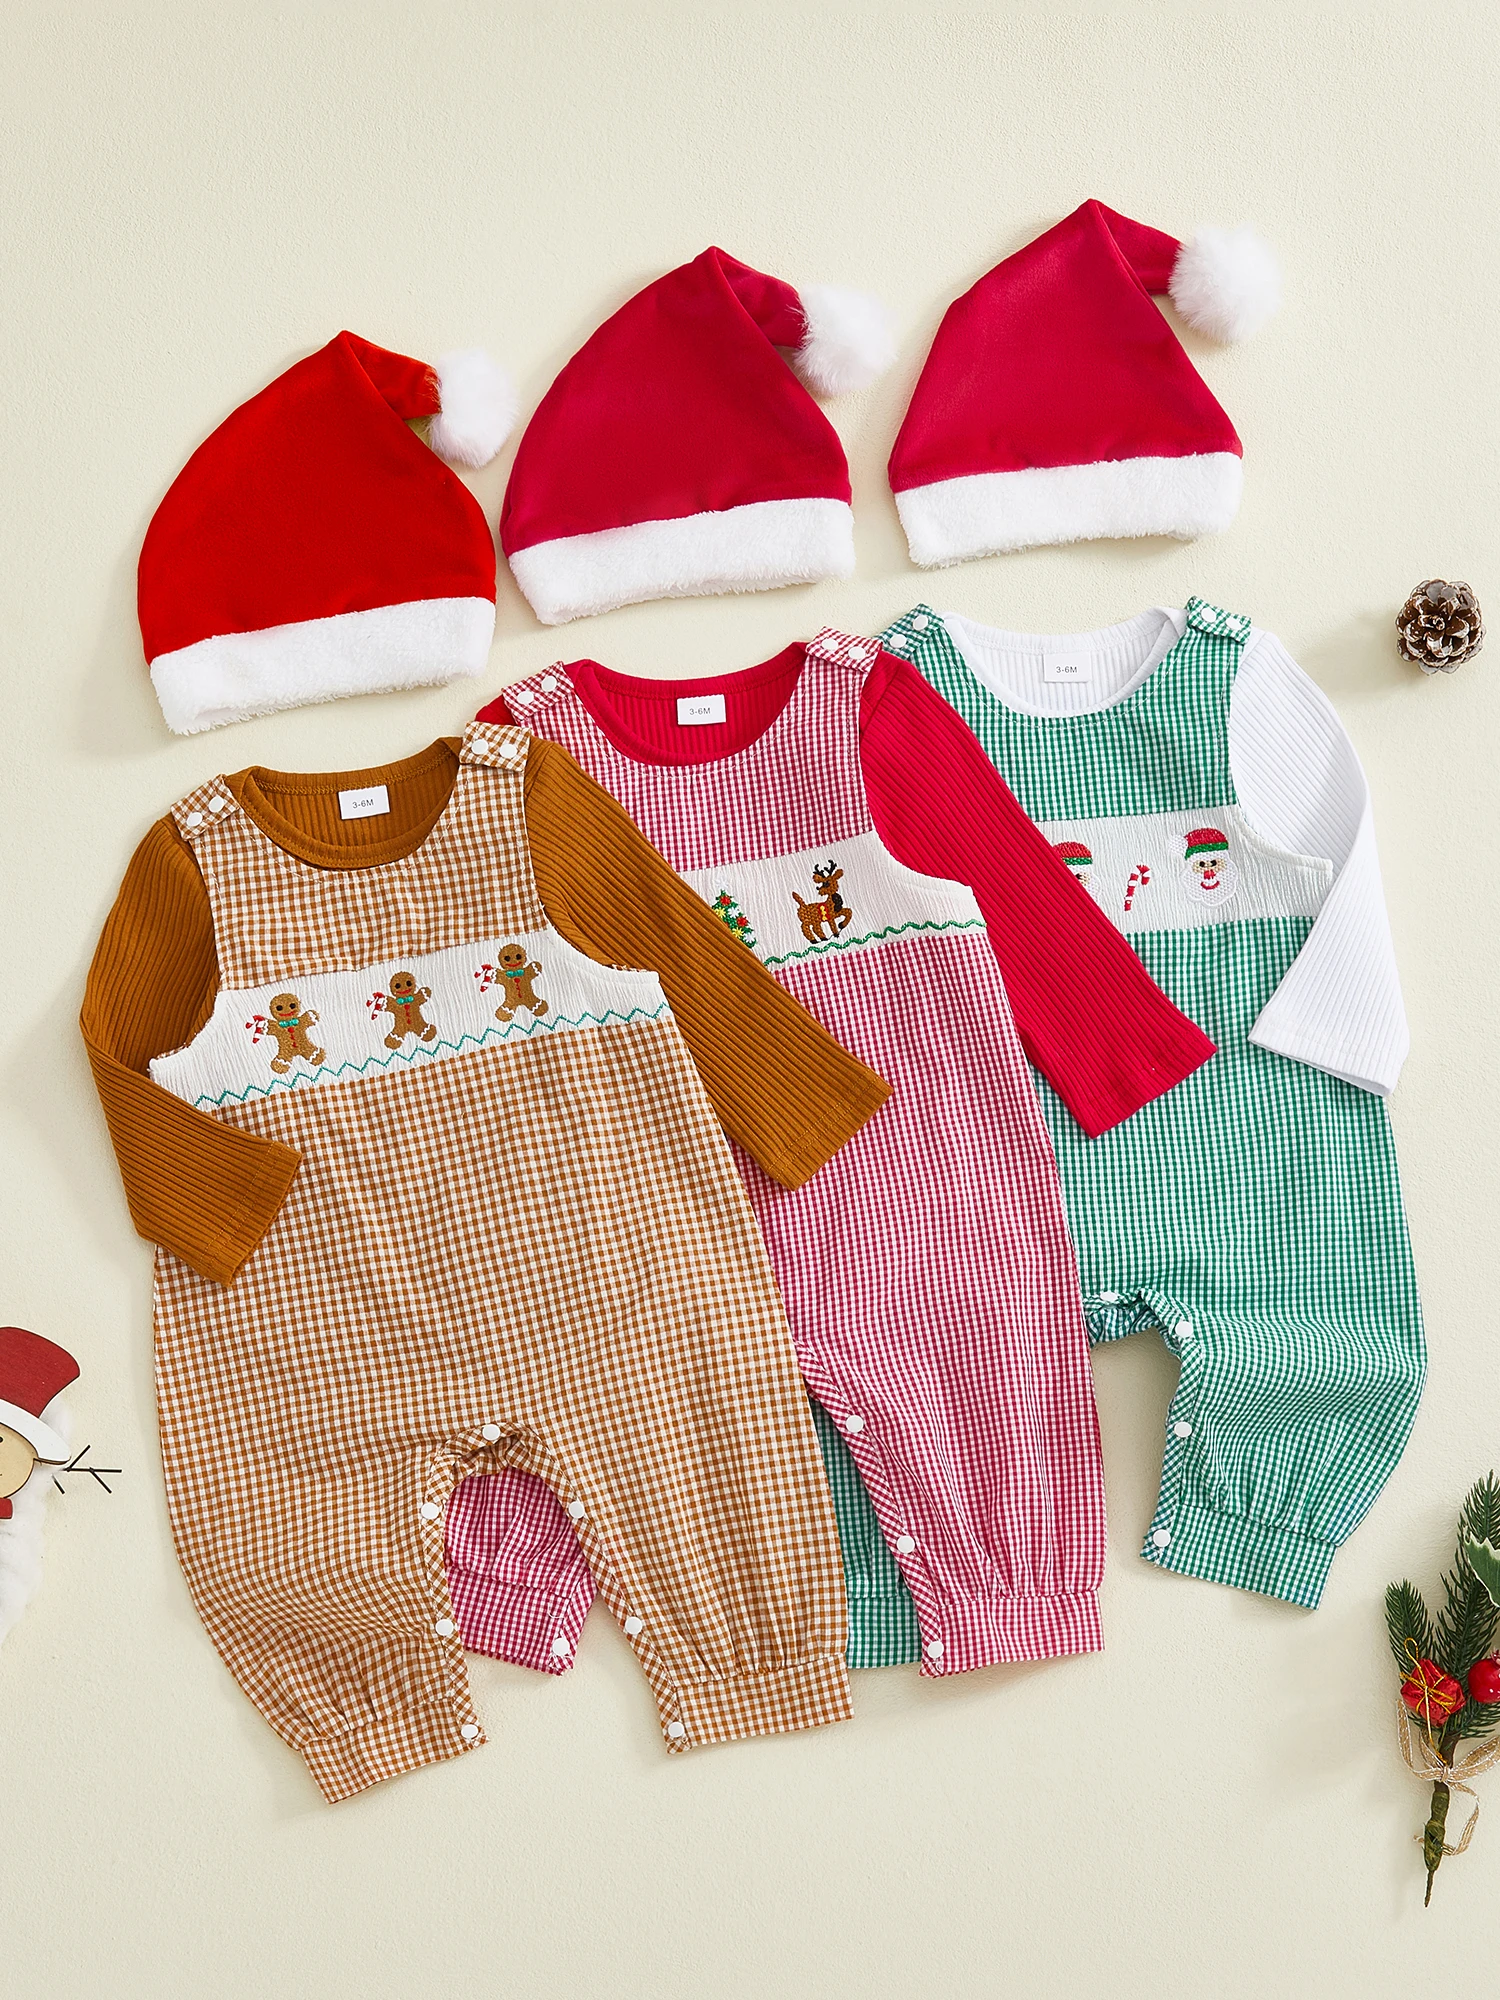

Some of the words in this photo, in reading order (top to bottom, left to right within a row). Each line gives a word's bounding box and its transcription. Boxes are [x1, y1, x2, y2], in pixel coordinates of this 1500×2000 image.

[1055, 665, 1078, 674] 3-6M
[689, 707, 711, 716] 3-6M
[352, 798, 374, 809] 3-6M
